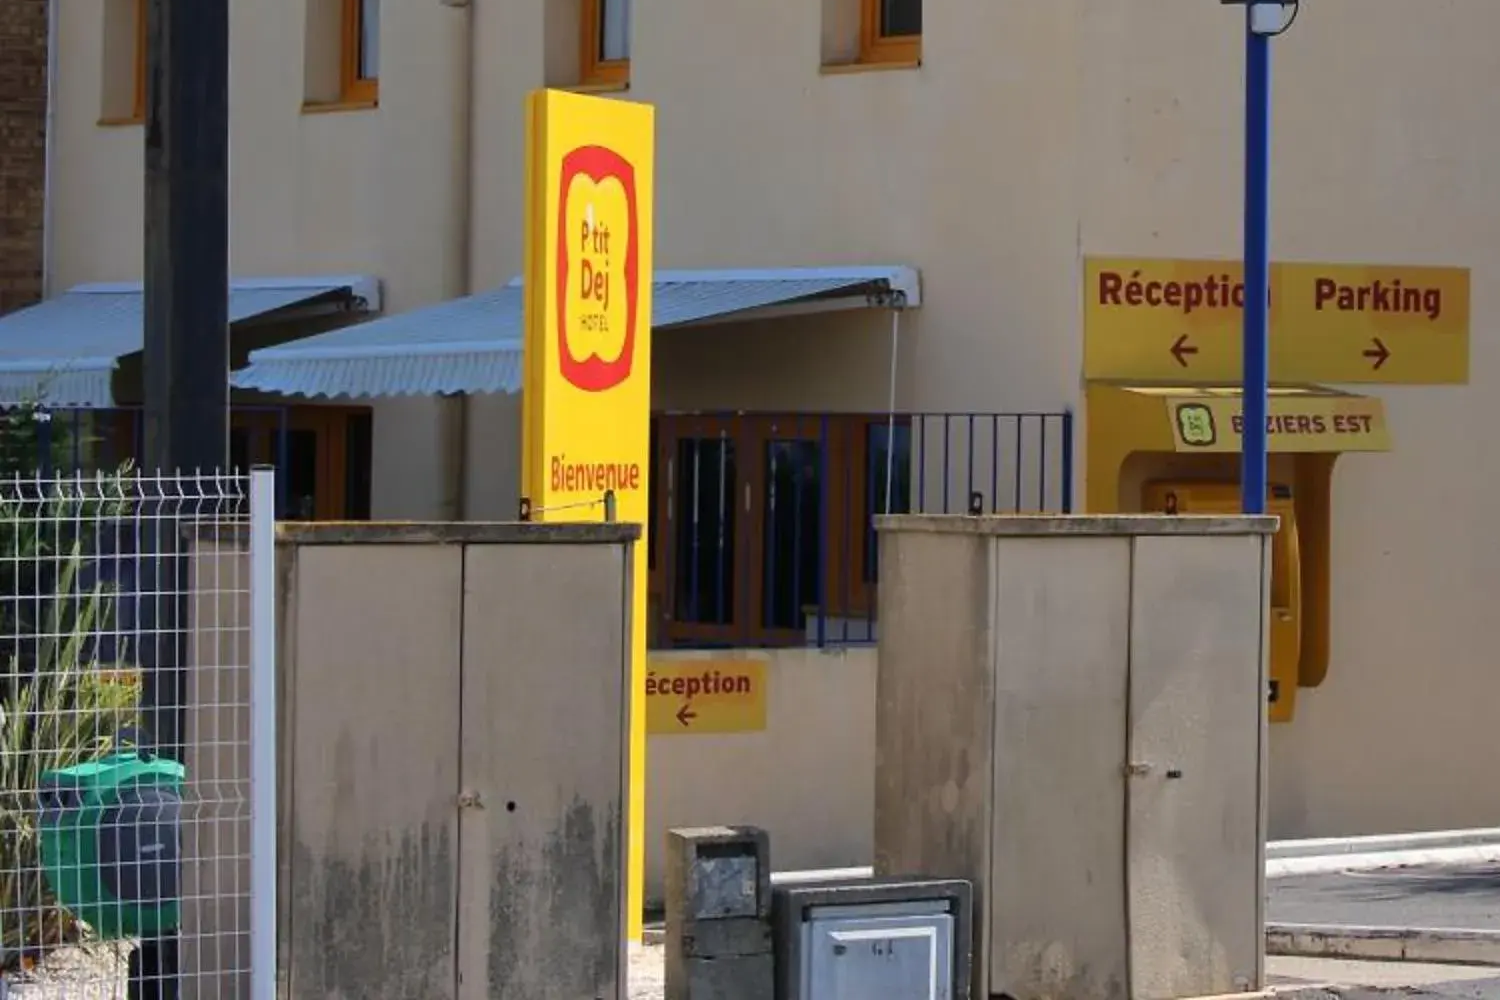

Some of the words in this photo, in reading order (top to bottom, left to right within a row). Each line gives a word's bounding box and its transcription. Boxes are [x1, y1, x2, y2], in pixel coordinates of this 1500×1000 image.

[581, 258, 609, 312] Dej
[1099, 270, 1271, 314] Réceptio
[1315, 278, 1442, 320] Parking
[1232, 415, 1326, 434] BZIERS
[1334, 415, 1372, 433] EST
[551, 453, 639, 491] Bienvenue
[646, 670, 751, 699] éception
